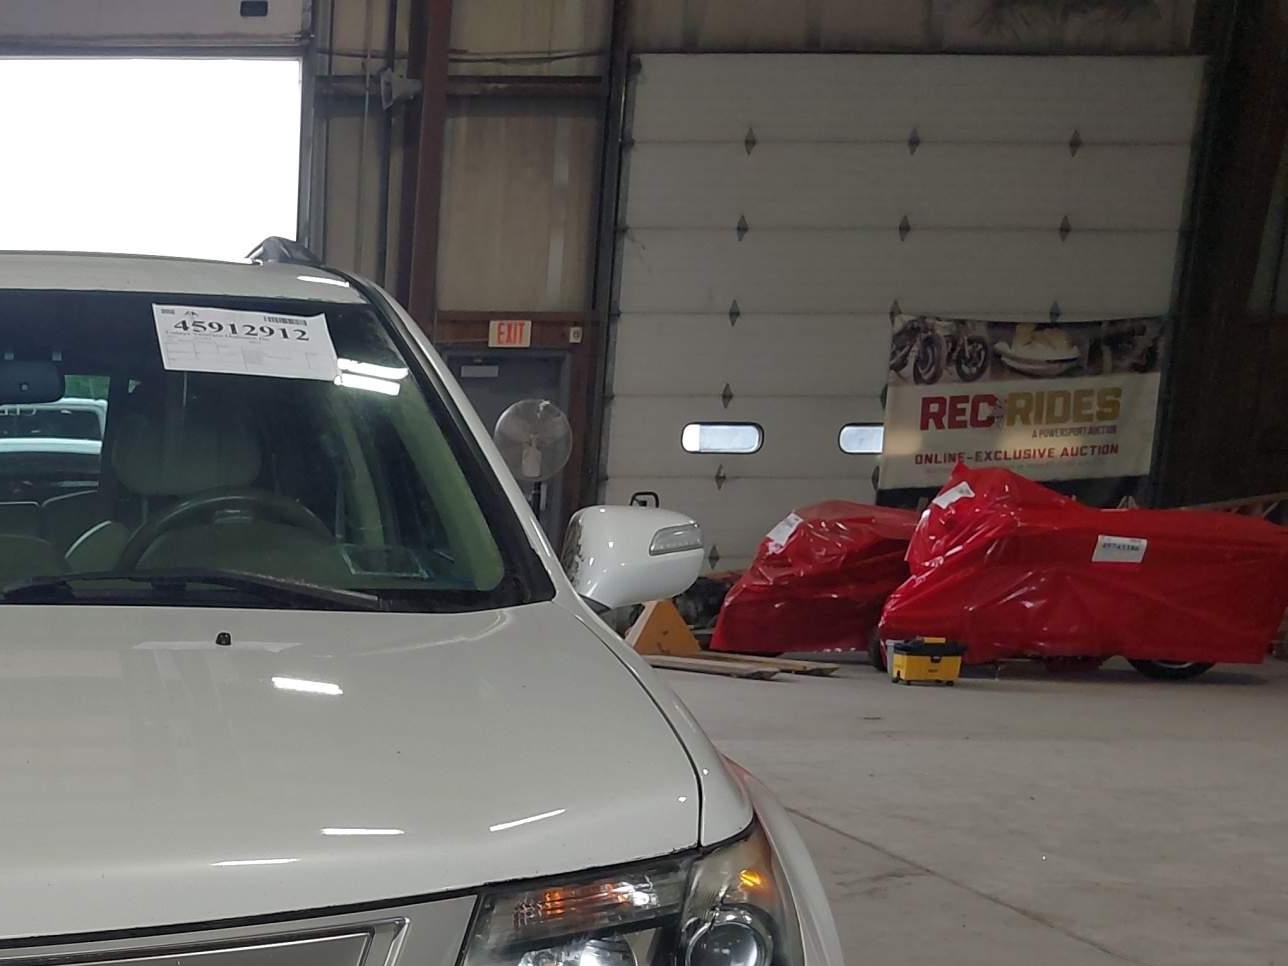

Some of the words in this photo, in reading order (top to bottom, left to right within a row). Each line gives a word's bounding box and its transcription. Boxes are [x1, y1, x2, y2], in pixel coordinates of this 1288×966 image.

[174, 320, 309, 341] 45912912
[497, 321, 525, 345] EXIT
[1006, 386, 1123, 427] RIDES
[915, 448, 1054, 464] ONLINE-EXCLUSIVE
[1060, 444, 1119, 457] AUCTION
